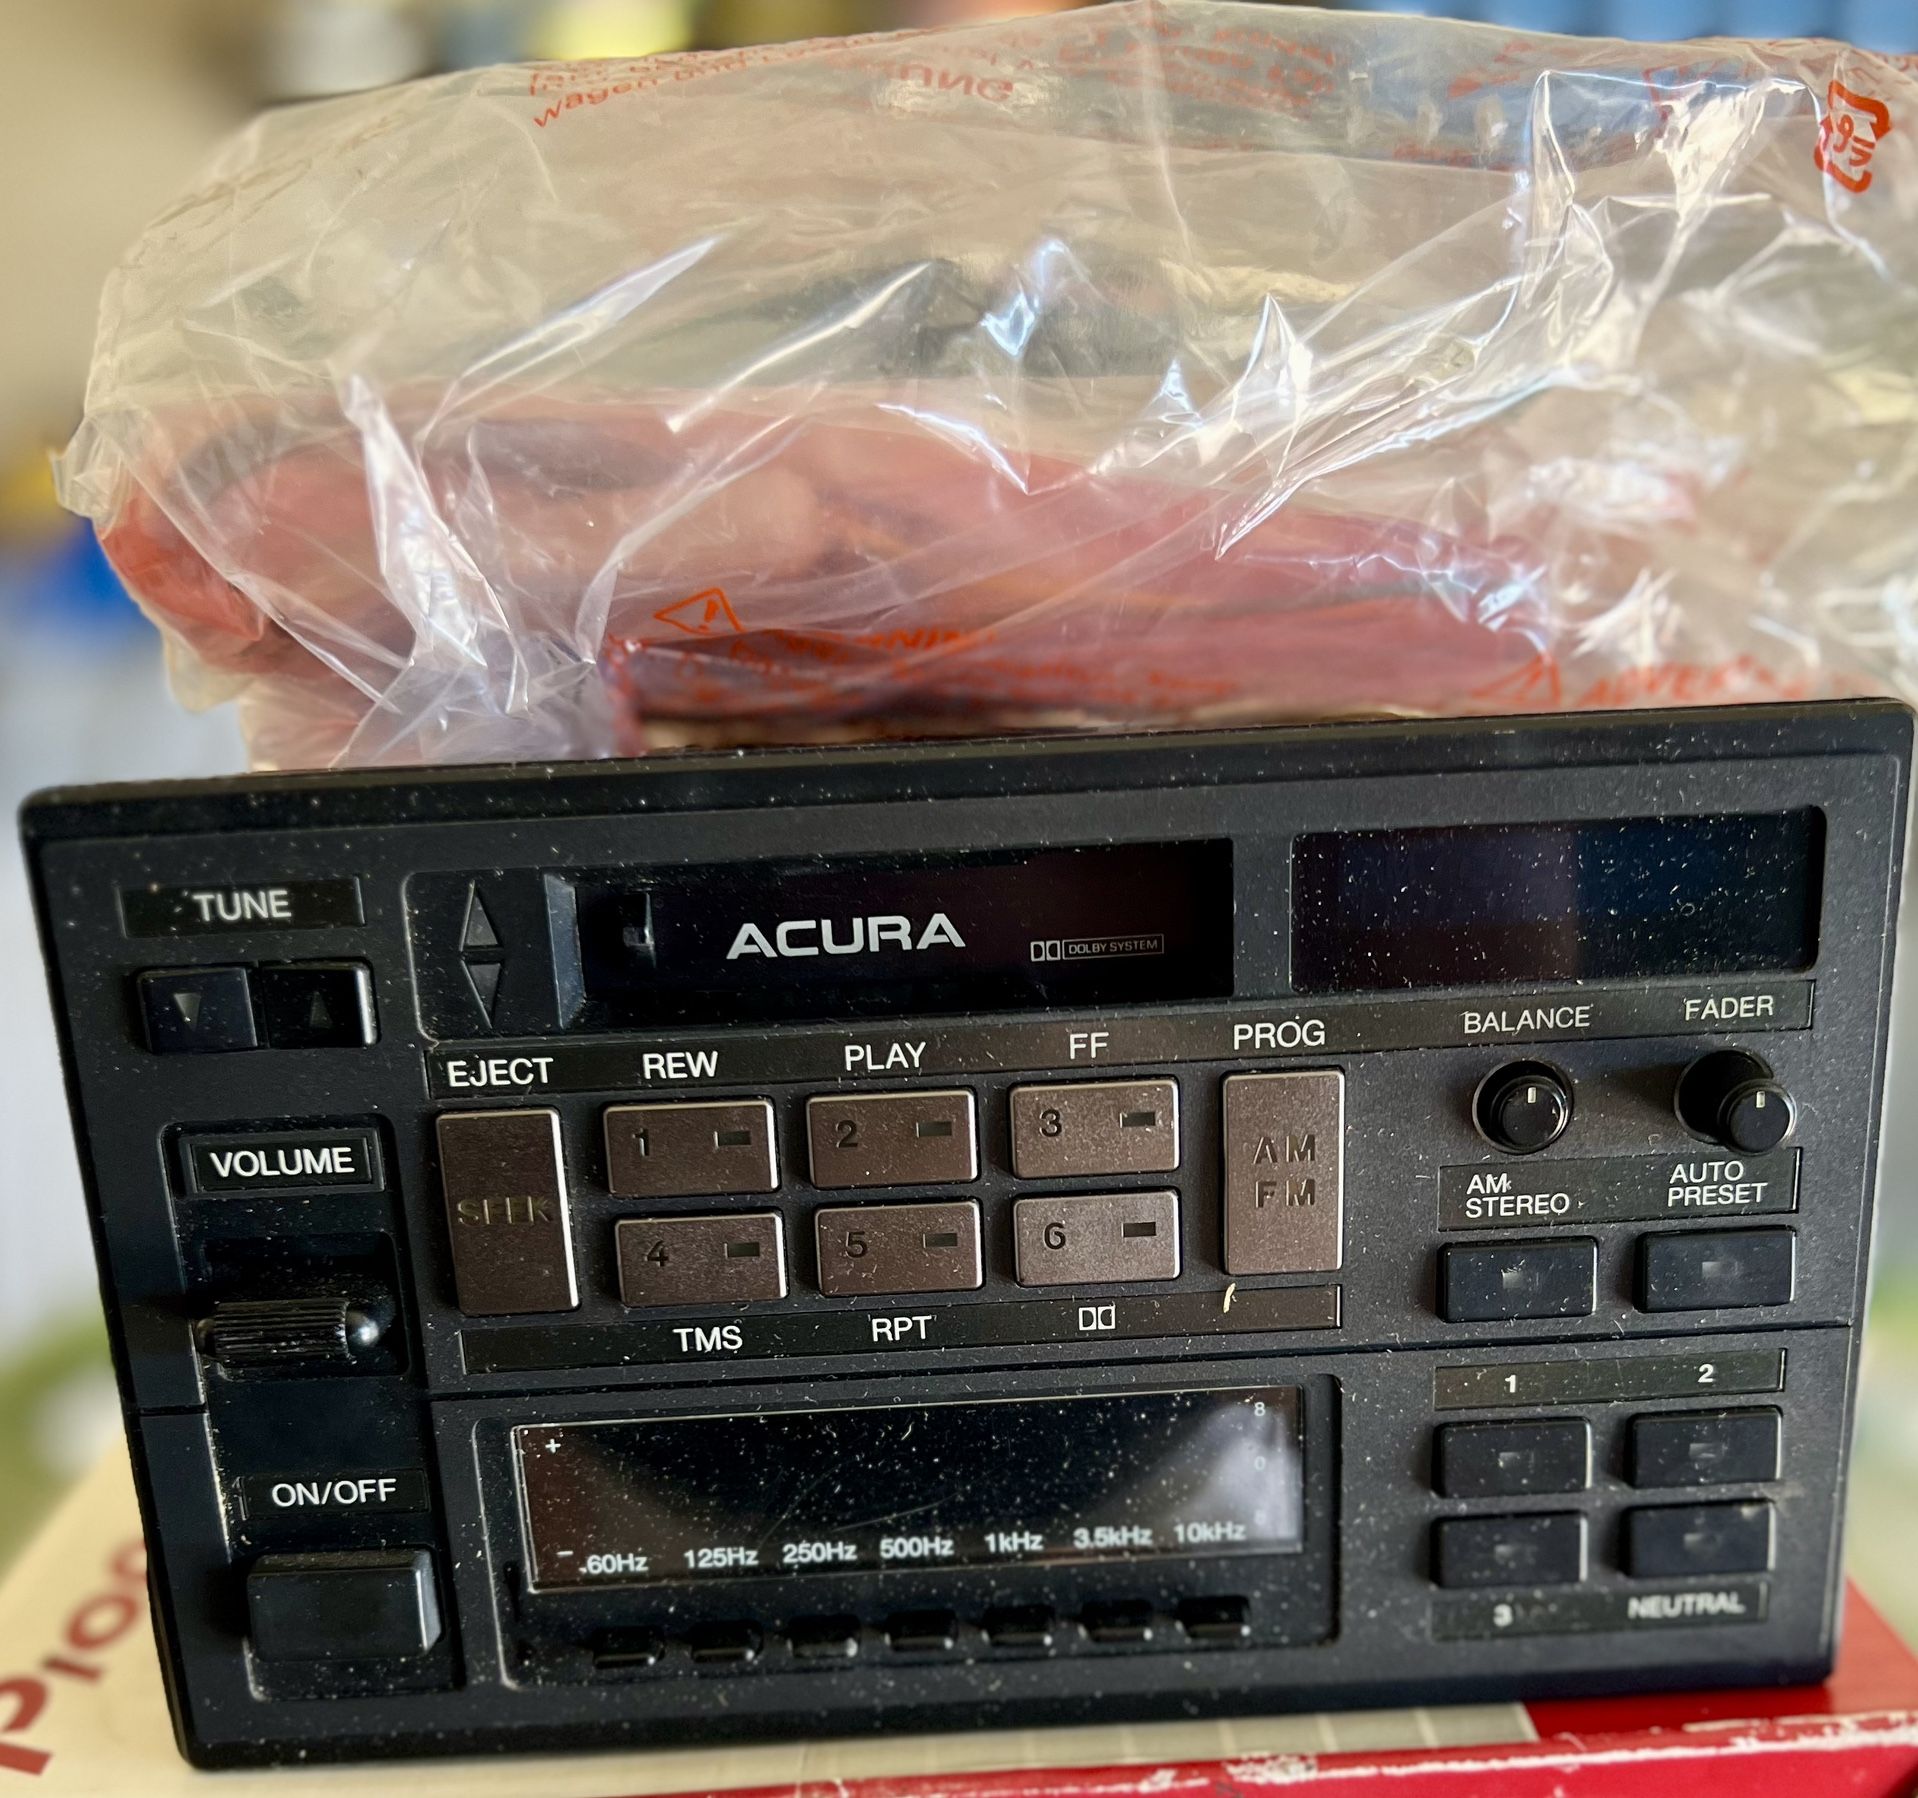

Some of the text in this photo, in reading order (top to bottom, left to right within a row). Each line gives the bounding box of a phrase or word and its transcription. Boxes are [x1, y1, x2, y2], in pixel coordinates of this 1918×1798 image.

[193, 889, 292, 922] TUNE
[726, 912, 966, 960] ACURA
[1068, 943, 1107, 955] DOLBY
[1109, 939, 1159, 953] SYSTEM
[1463, 1005, 1591, 1034] BALANCE
[1685, 995, 1774, 1021] FADER
[1069, 1032, 1110, 1060] FF
[1233, 1020, 1326, 1050] PROG
[642, 1050, 719, 1080] REW
[844, 1042, 927, 1071] PLAY
[447, 1057, 554, 1087] EJECT
[834, 1119, 859, 1149] 2
[1039, 1108, 1063, 1138] 3
[632, 1127, 650, 1157] 1
[1253, 1133, 1317, 1165] AM
[209, 1146, 356, 1178] VOLUME
[1669, 1160, 1744, 1184] AUTO
[1254, 1179, 1317, 1209] FM
[1466, 1173, 1508, 1195] AM
[1667, 1182, 1768, 1207] PRESET
[1465, 1192, 1570, 1219] STEREO
[844, 1230, 868, 1259] 5
[1043, 1221, 1067, 1251] 6
[646, 1240, 669, 1268] 4
[672, 1325, 743, 1353] TMS
[872, 1314, 933, 1342] RPT
[1504, 1374, 1517, 1394] 1
[1697, 1363, 1715, 1383] 2
[1254, 1401, 1266, 1417] 8
[271, 1478, 397, 1507] ON/OFF
[586, 1520, 1247, 1575] 60Hz 125Hz 250Hz 500Hz 1kHz 3.5kHz 10kHz
[1627, 1591, 1747, 1620] NEUTRAL
